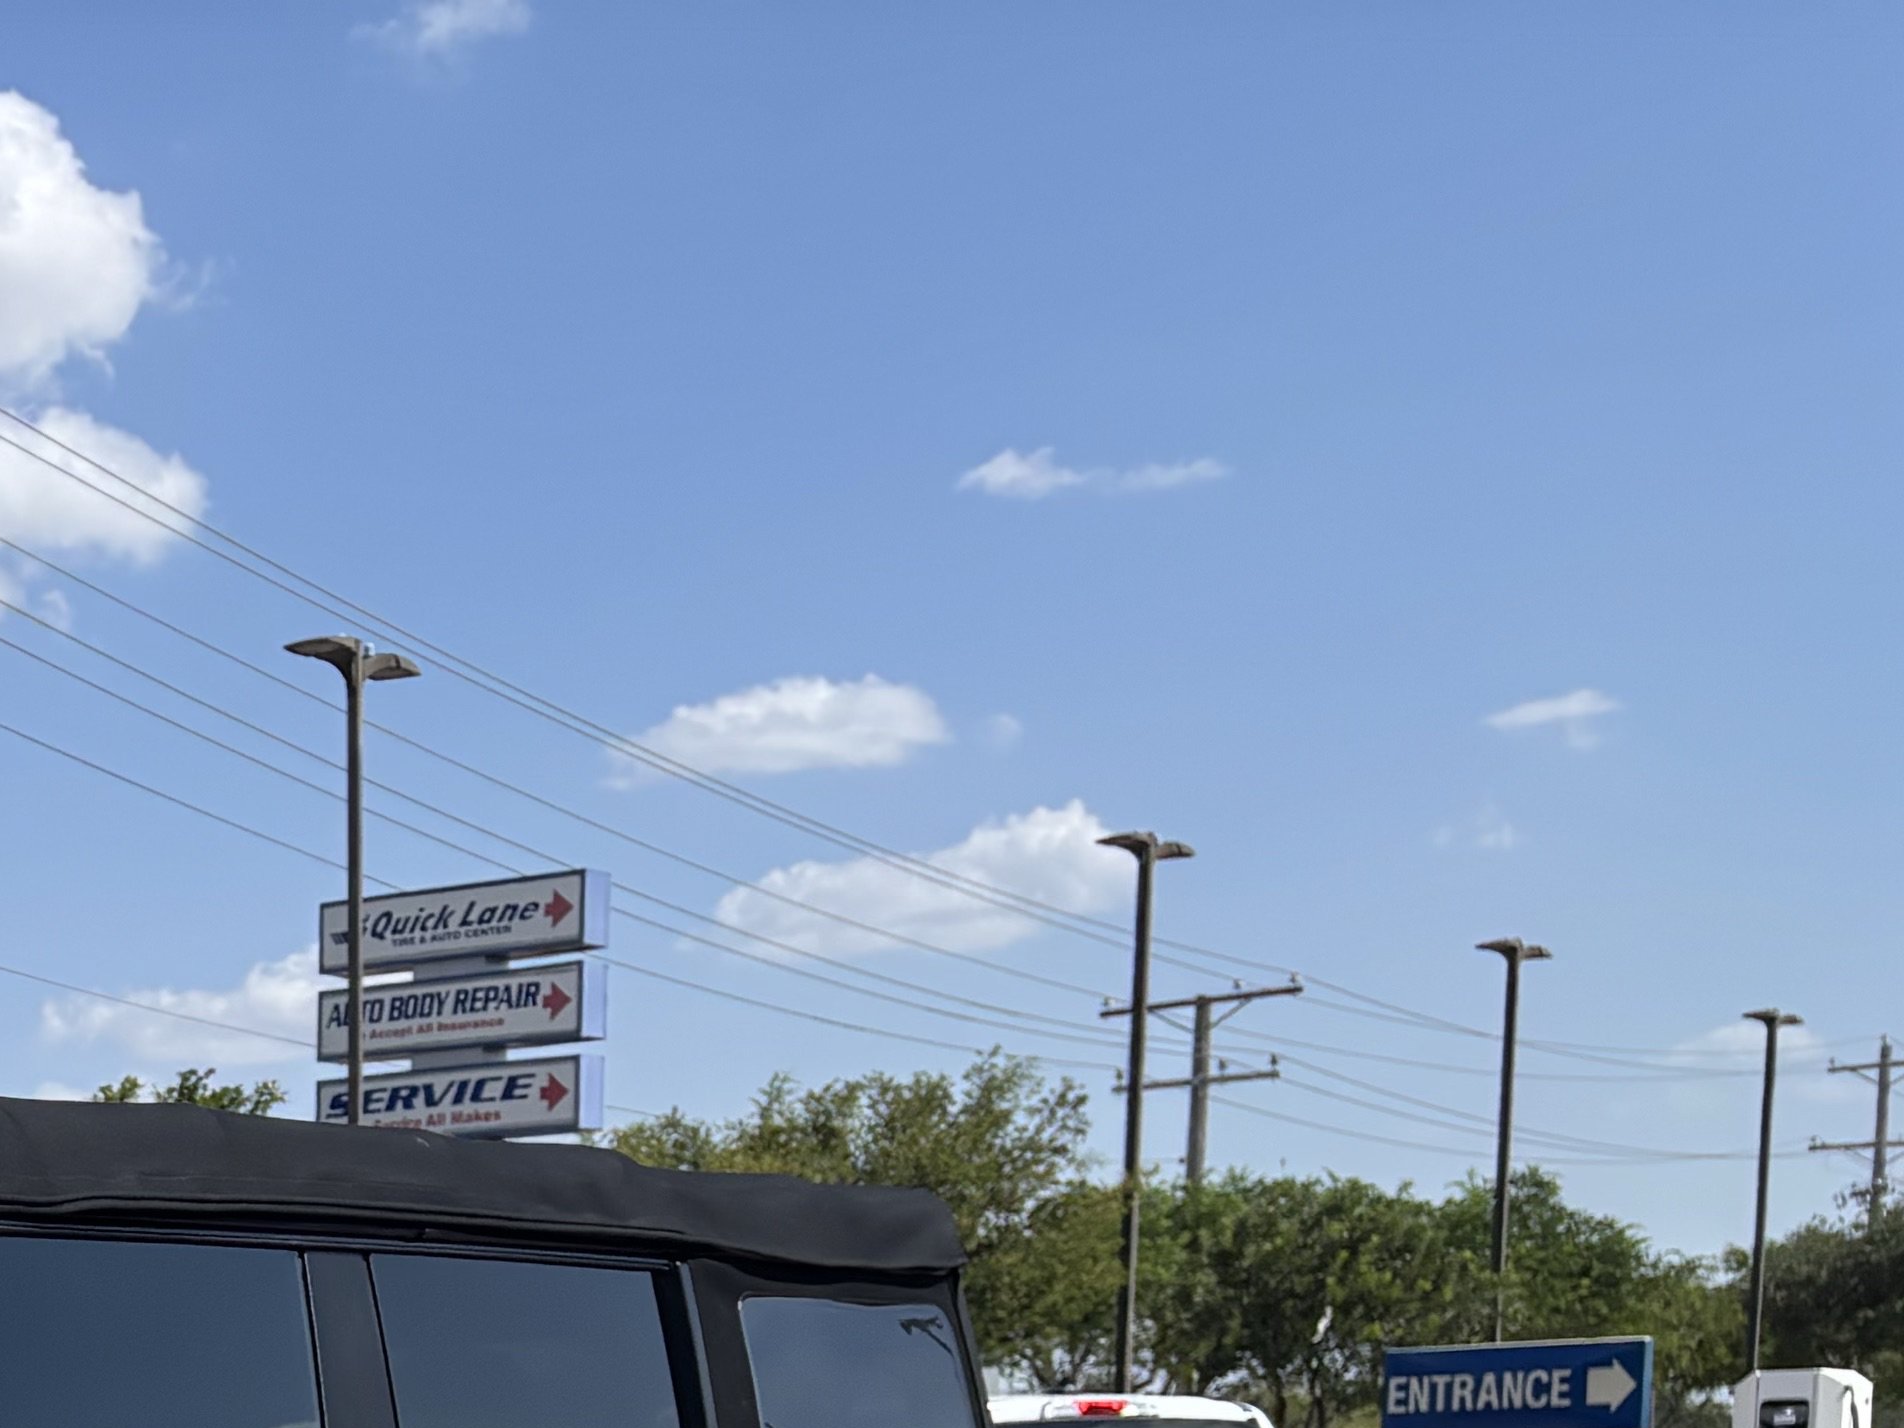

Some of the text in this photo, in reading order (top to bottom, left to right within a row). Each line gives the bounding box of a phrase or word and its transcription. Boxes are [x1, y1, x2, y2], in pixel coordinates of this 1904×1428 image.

[371, 900, 540, 941] Quick Lane
[430, 931, 462, 944] AUTO
[463, 925, 513, 939] CENTER
[387, 990, 451, 1022] BODY
[451, 981, 541, 1016] REPAIR
[369, 1017, 506, 1040] Accept All Insurance
[325, 1073, 537, 1119] SERVICE
[426, 1112, 447, 1127] All
[450, 1109, 502, 1126] Makes
[1386, 1367, 1573, 1416] ENTRANCE
